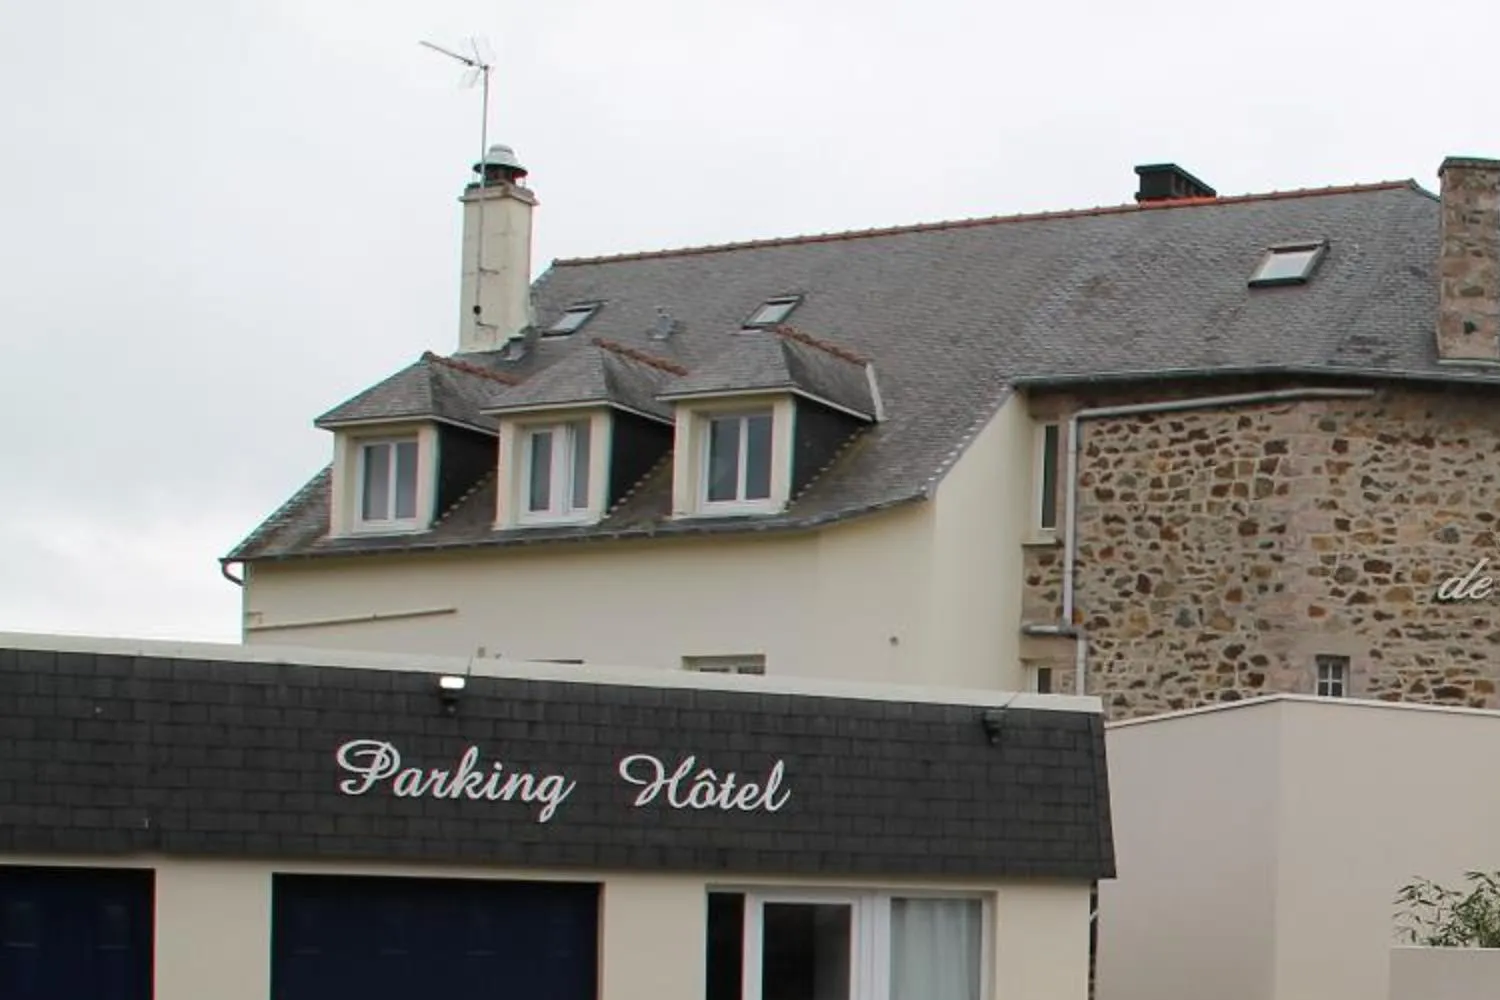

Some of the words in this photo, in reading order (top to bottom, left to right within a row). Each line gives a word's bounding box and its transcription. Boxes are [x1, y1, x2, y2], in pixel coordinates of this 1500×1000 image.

[1437, 557, 1493, 599] de
[336, 739, 577, 822] Parking
[619, 753, 791, 812] Hôtel
